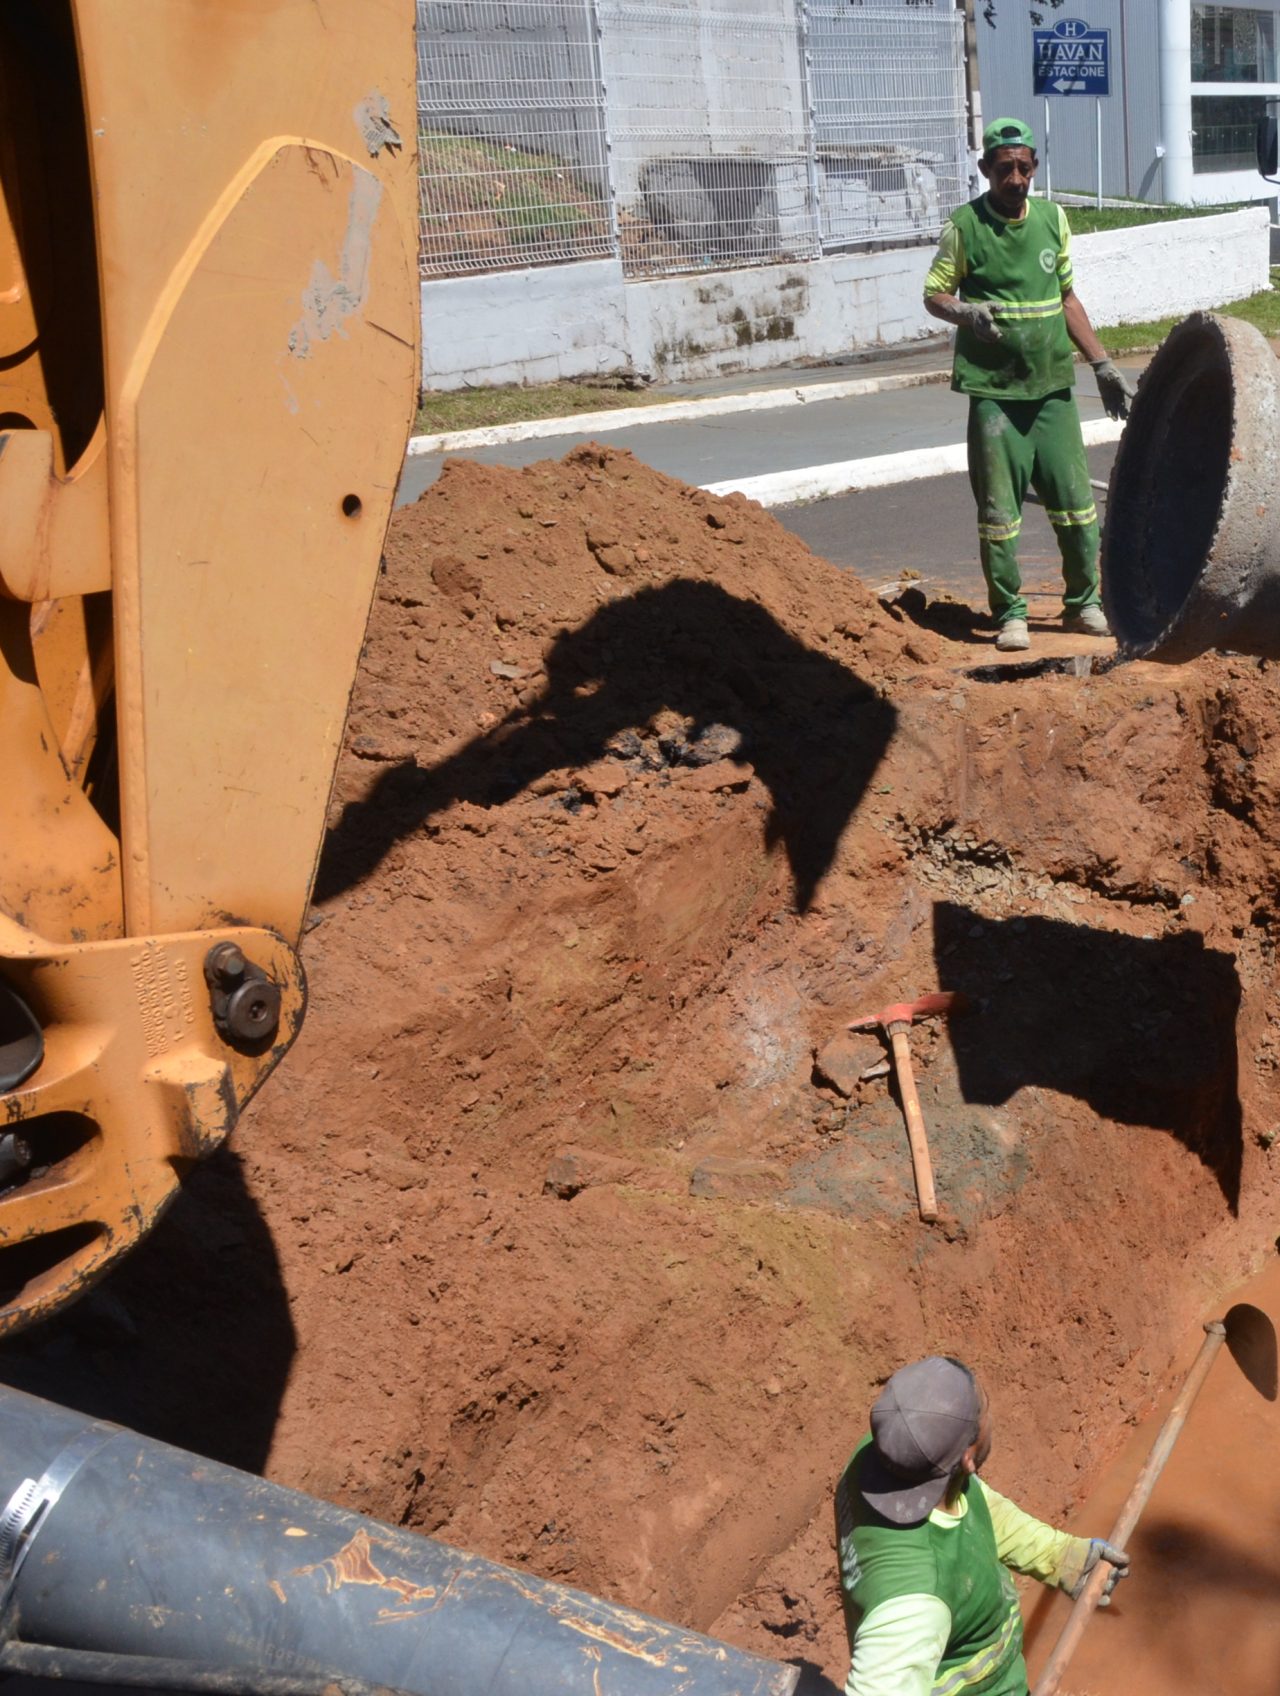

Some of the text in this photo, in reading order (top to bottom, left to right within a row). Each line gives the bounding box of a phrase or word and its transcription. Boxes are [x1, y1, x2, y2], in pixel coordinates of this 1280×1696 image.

[1064, 22, 1077, 37] H
[1038, 44, 1103, 61] HAVAN
[1038, 66, 1105, 77] ESTACIONE
